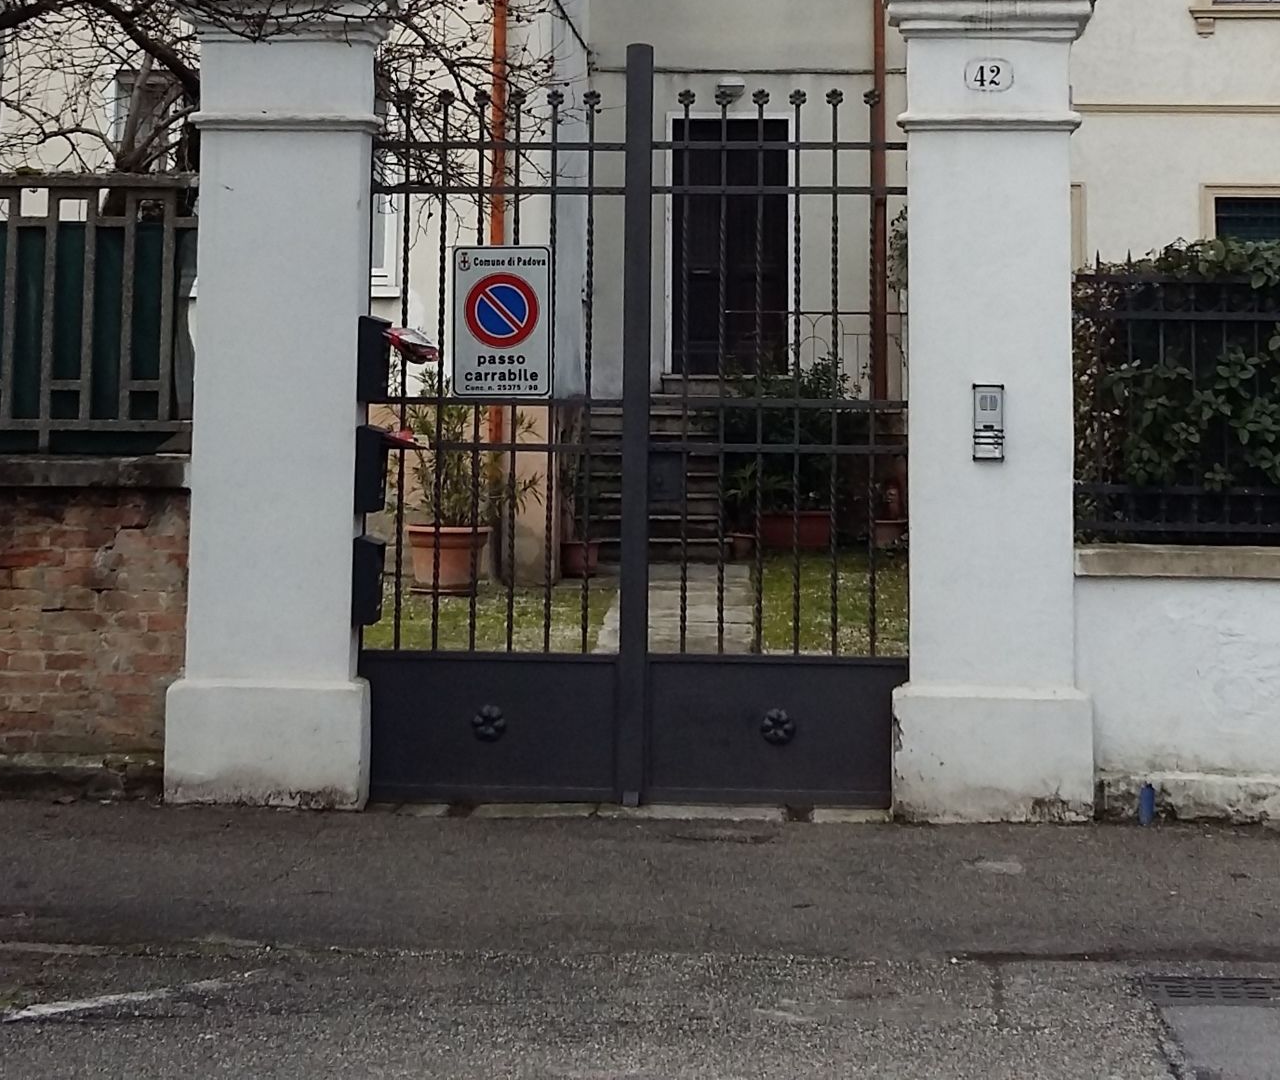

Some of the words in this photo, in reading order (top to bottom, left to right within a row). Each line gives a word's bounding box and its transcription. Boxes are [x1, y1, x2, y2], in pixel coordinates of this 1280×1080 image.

[973, 65, 1001, 87] 42
[473, 257, 505, 267] Comune
[507, 257, 515, 267] di
[517, 256, 546, 267] Padova
[477, 354, 526, 367] passo
[464, 368, 539, 382] carrabile
